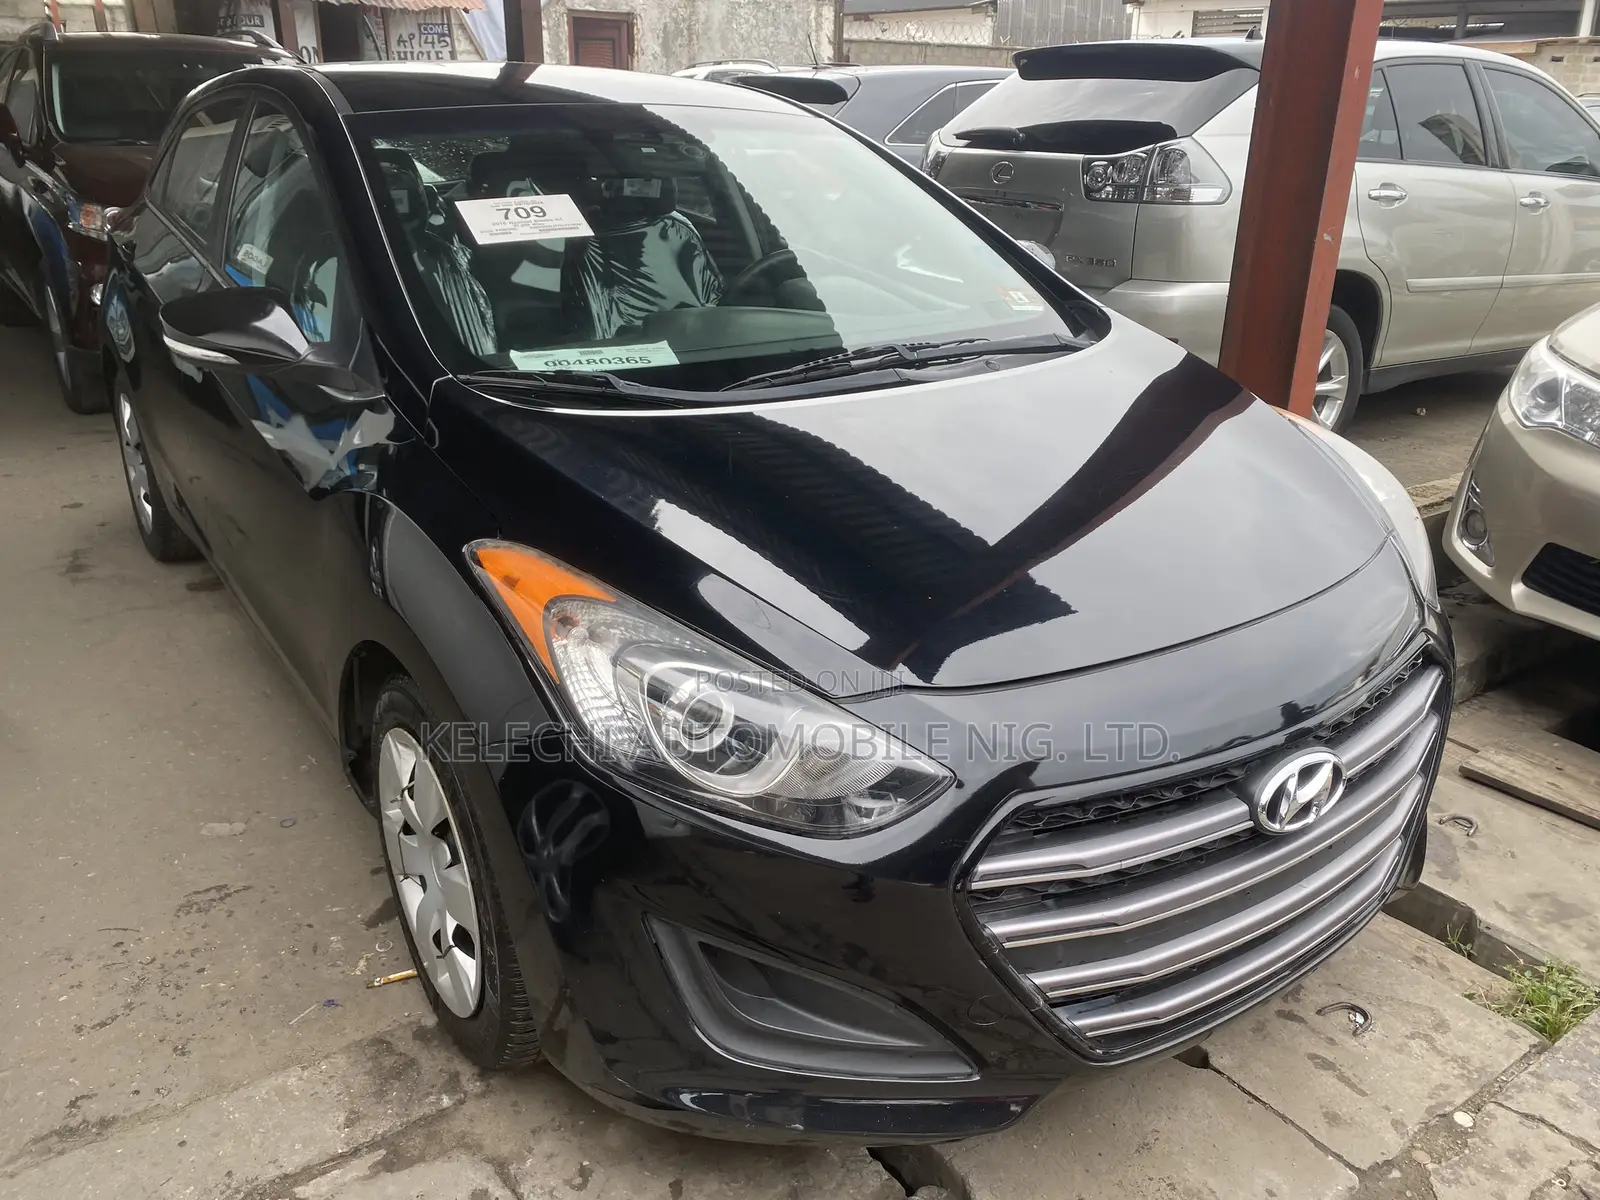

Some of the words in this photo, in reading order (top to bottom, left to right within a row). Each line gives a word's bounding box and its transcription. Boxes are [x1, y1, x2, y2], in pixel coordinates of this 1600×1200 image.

[421, 24, 448, 33] COME
[496, 205, 547, 220] 709
[544, 356, 652, 368] 00480365
